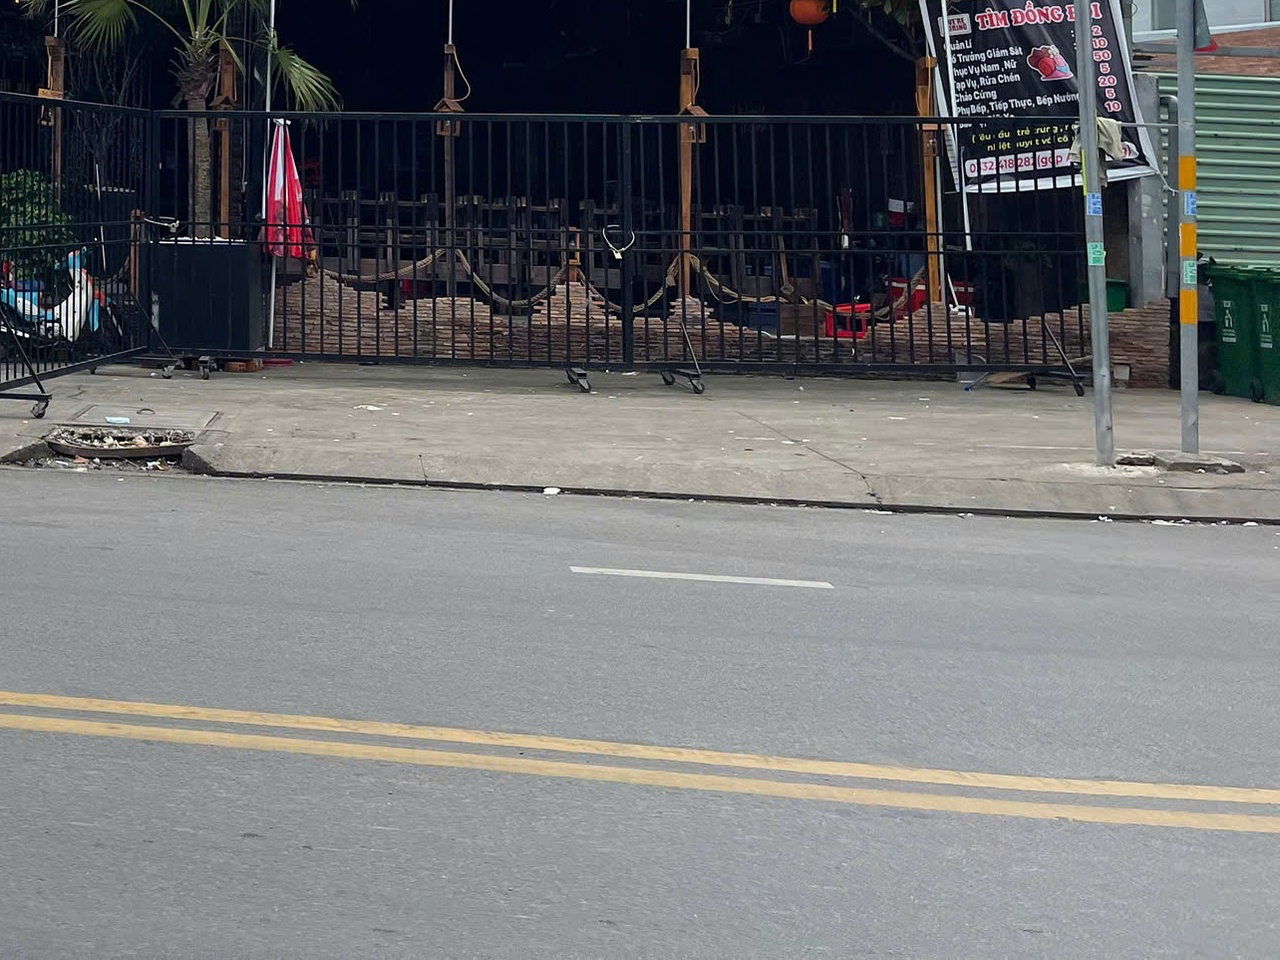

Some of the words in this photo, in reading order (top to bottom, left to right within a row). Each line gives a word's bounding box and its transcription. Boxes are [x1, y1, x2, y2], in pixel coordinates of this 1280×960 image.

[976, 8, 1010, 29] TÌM
[1011, 1, 1063, 25] ĐỒNG
[1091, 25, 1102, 36] 2
[1092, 37, 1108, 48] 10
[954, 67, 968, 77] hục
[980, 63, 999, 73] Nam
[1093, 50, 1112, 61] 50
[1100, 62, 1110, 73] 5
[1098, 75, 1117, 87] 20
[1105, 88, 1116, 99] 5
[1104, 100, 1122, 112] 10
